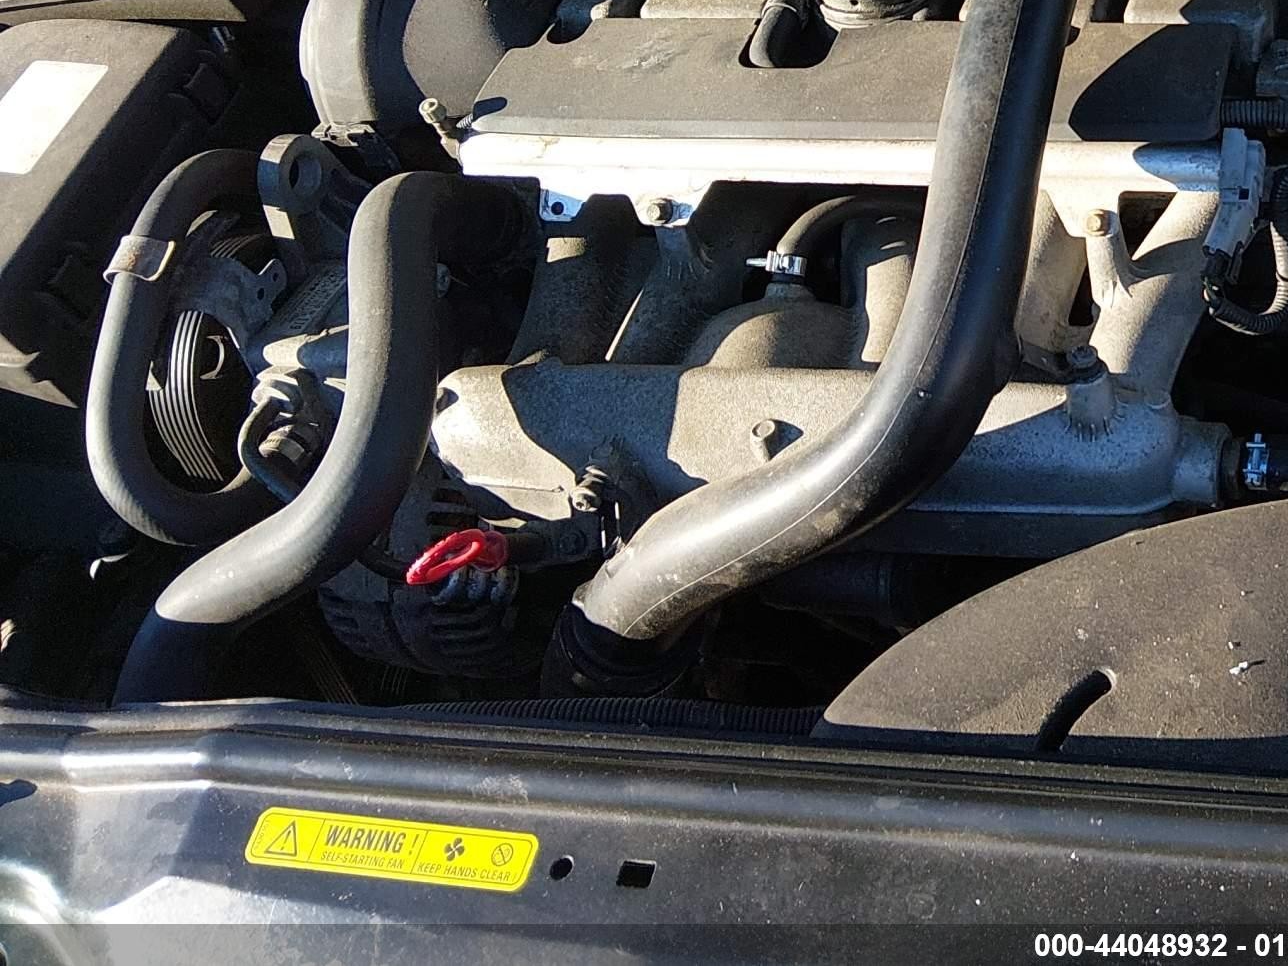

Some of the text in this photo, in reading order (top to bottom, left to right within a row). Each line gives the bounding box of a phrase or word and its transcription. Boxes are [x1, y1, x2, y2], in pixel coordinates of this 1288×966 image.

[324, 824, 407, 854] WARNING
[320, 852, 406, 871] SELF-STARTING FAN
[418, 862, 442, 874] KEEP
[443, 864, 478, 878] HANDS
[479, 868, 511, 881] CLEAR
